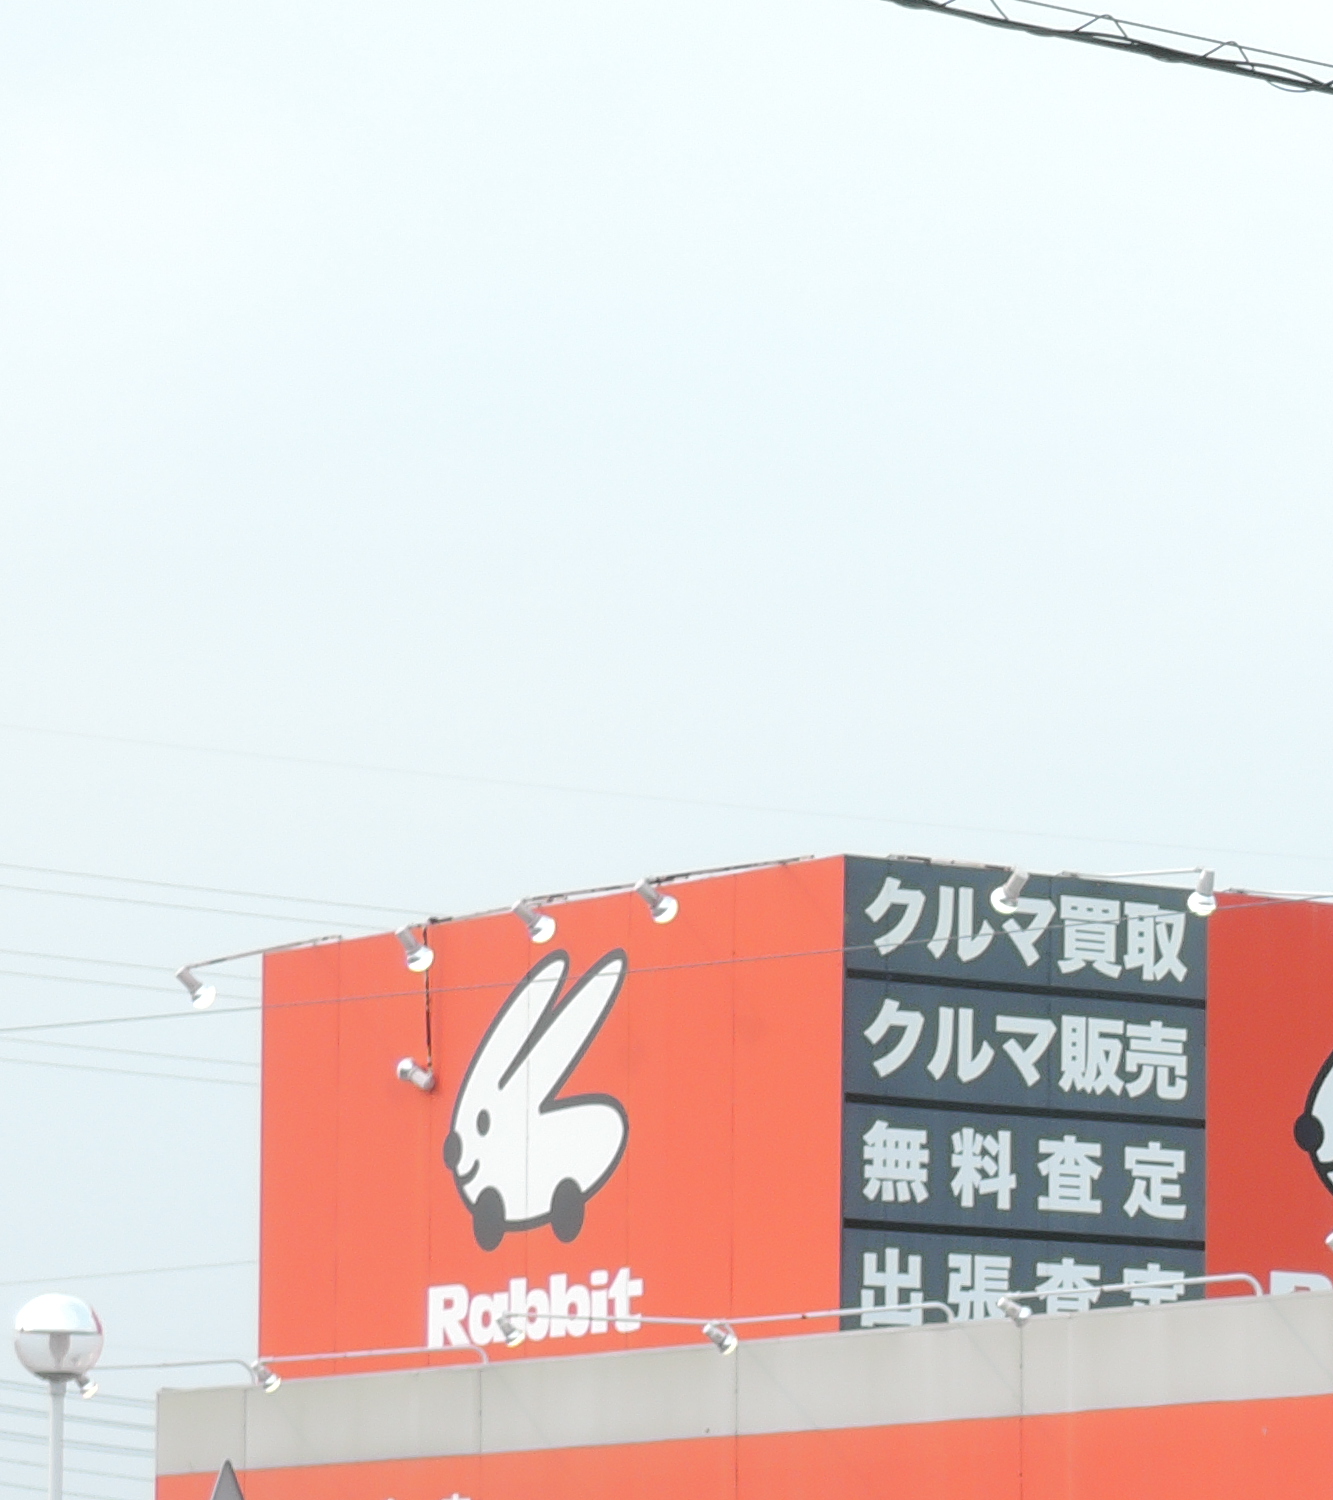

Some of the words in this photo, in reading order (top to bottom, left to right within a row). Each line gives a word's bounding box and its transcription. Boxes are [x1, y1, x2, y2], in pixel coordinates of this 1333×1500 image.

[865, 876, 1188, 982] クルマ買取
[864, 998, 1188, 1101] クルマ販売
[862, 1120, 1188, 1220] 無料査定
[428, 1267, 644, 1349] Rabbit
